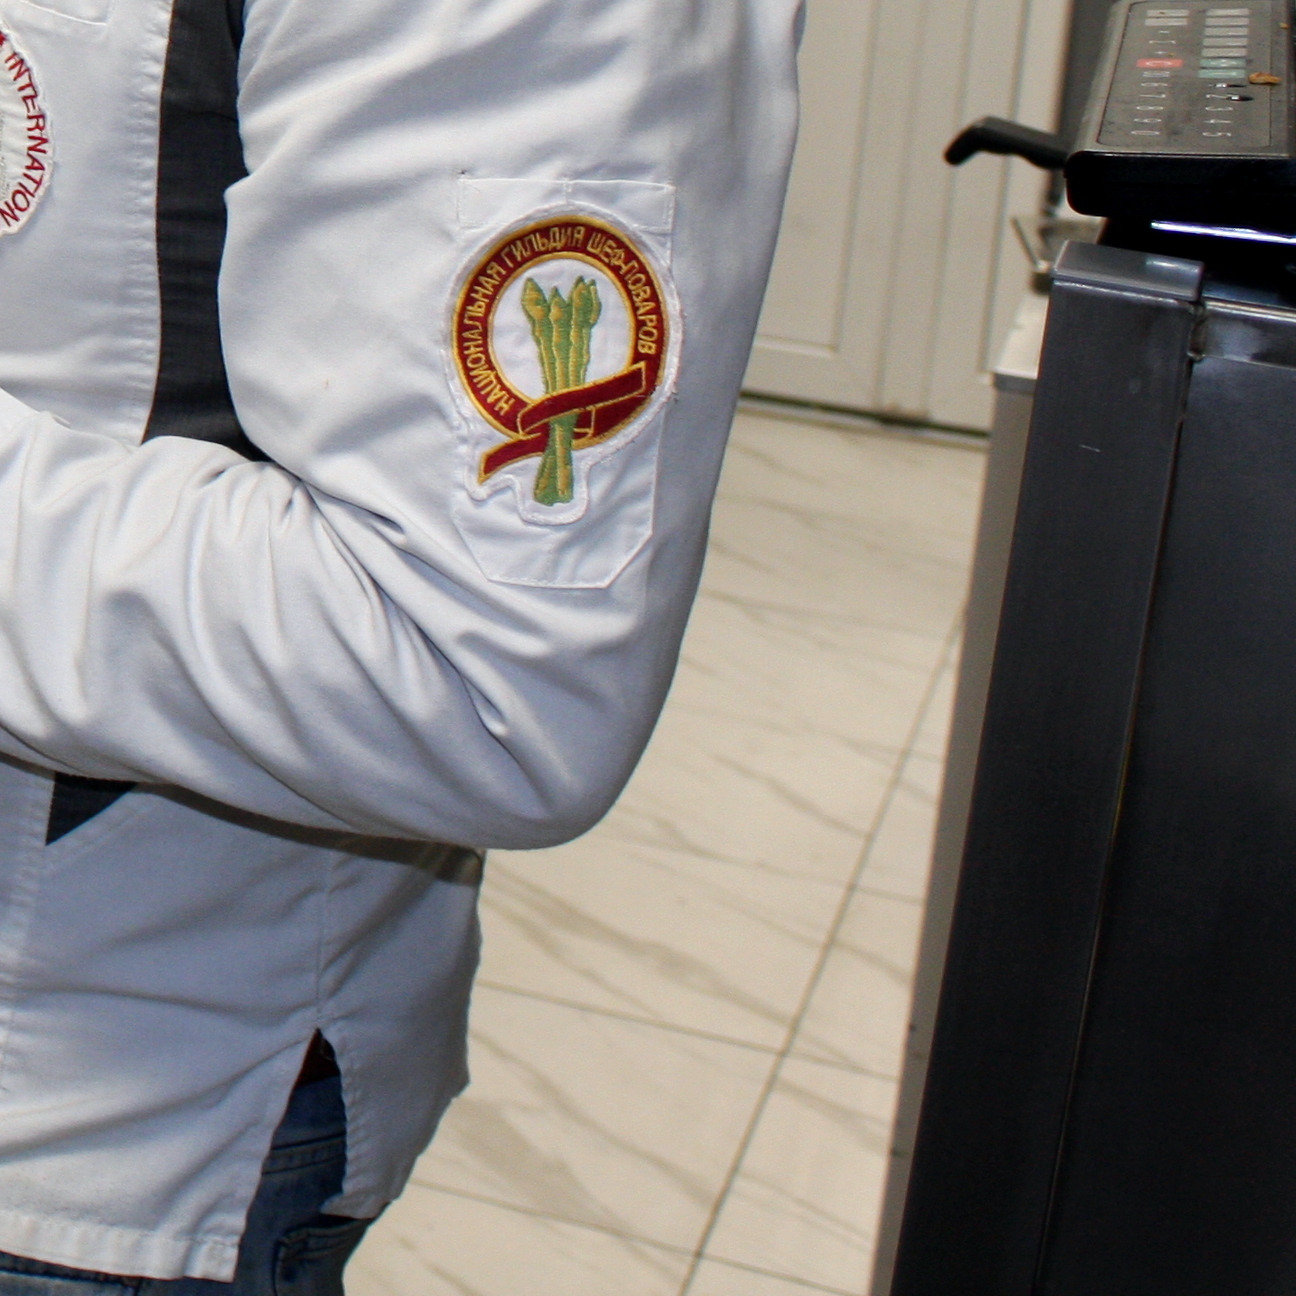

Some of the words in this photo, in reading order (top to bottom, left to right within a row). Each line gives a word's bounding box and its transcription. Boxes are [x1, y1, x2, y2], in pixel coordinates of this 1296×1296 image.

[461, 264, 517, 417] НАЦИОНАЛЬНАЯ
[503, 225, 586, 269] ГИЛЬДИЯ
[585, 234, 657, 356] ШЕФ-ПОВАРОВ
